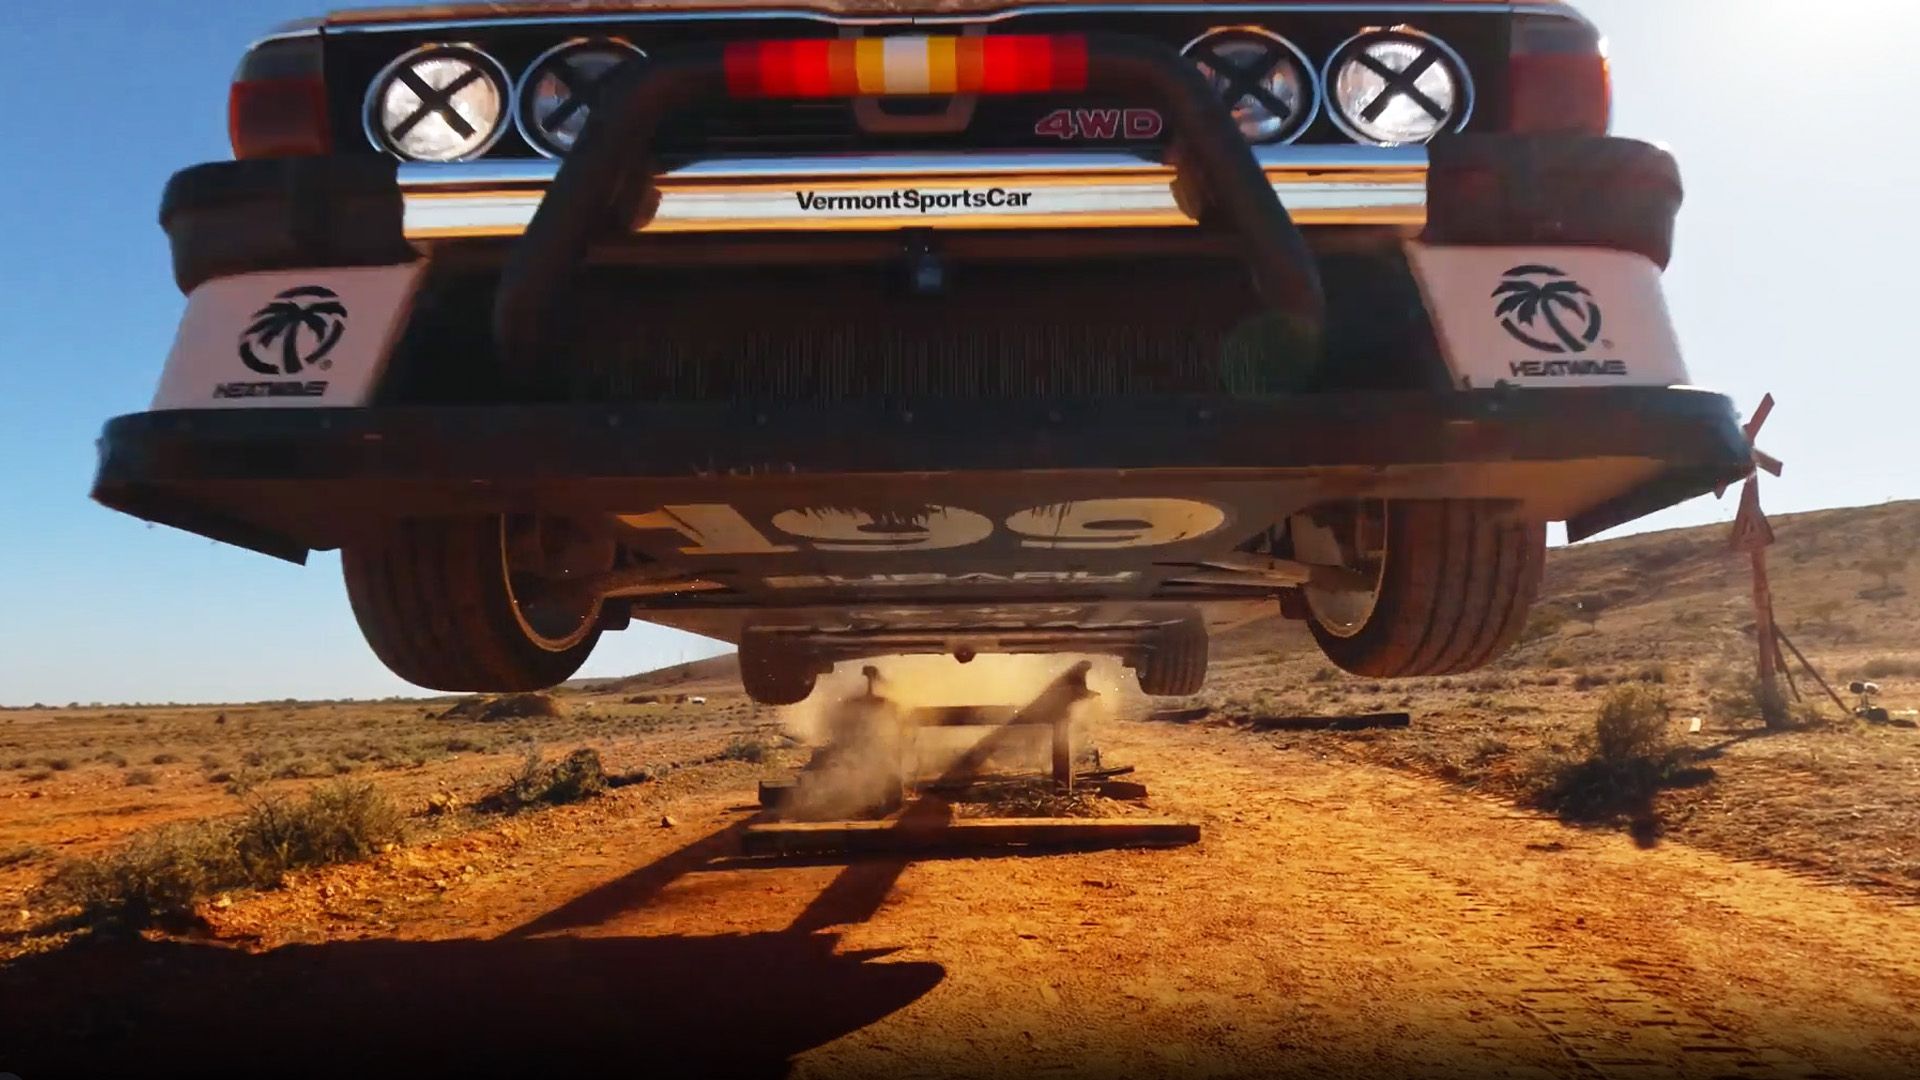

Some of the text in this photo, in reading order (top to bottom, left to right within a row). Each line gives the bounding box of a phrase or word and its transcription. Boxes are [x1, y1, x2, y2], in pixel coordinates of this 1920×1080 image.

[1035, 108, 1164, 139] 4WD
[796, 188, 1032, 212] VermontSportsCar
[616, 498, 1226, 554] 199
